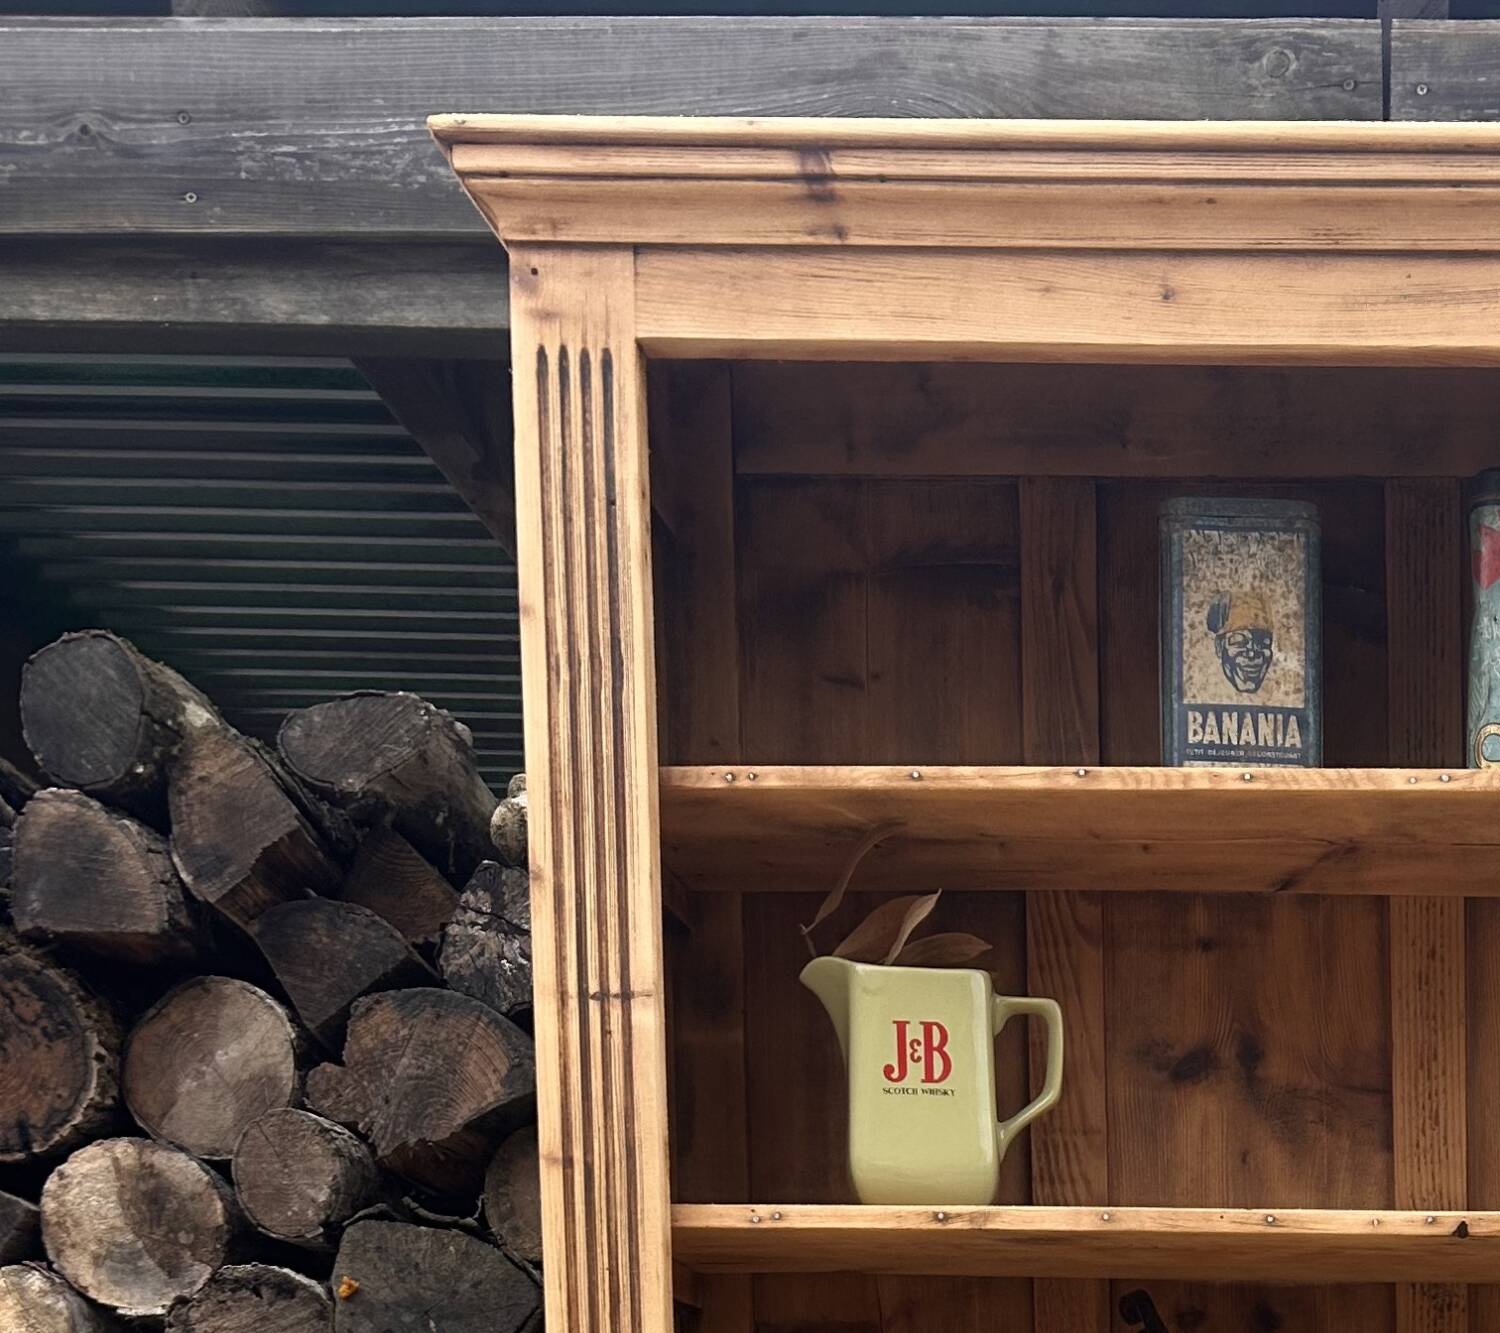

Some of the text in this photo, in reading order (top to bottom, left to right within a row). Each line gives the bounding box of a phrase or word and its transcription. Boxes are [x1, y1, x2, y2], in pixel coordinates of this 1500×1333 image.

[1187, 710, 1303, 748] BANANIA
[882, 1020, 953, 1084] J&B
[882, 1087, 956, 1096] SCOTCH WHISKY
